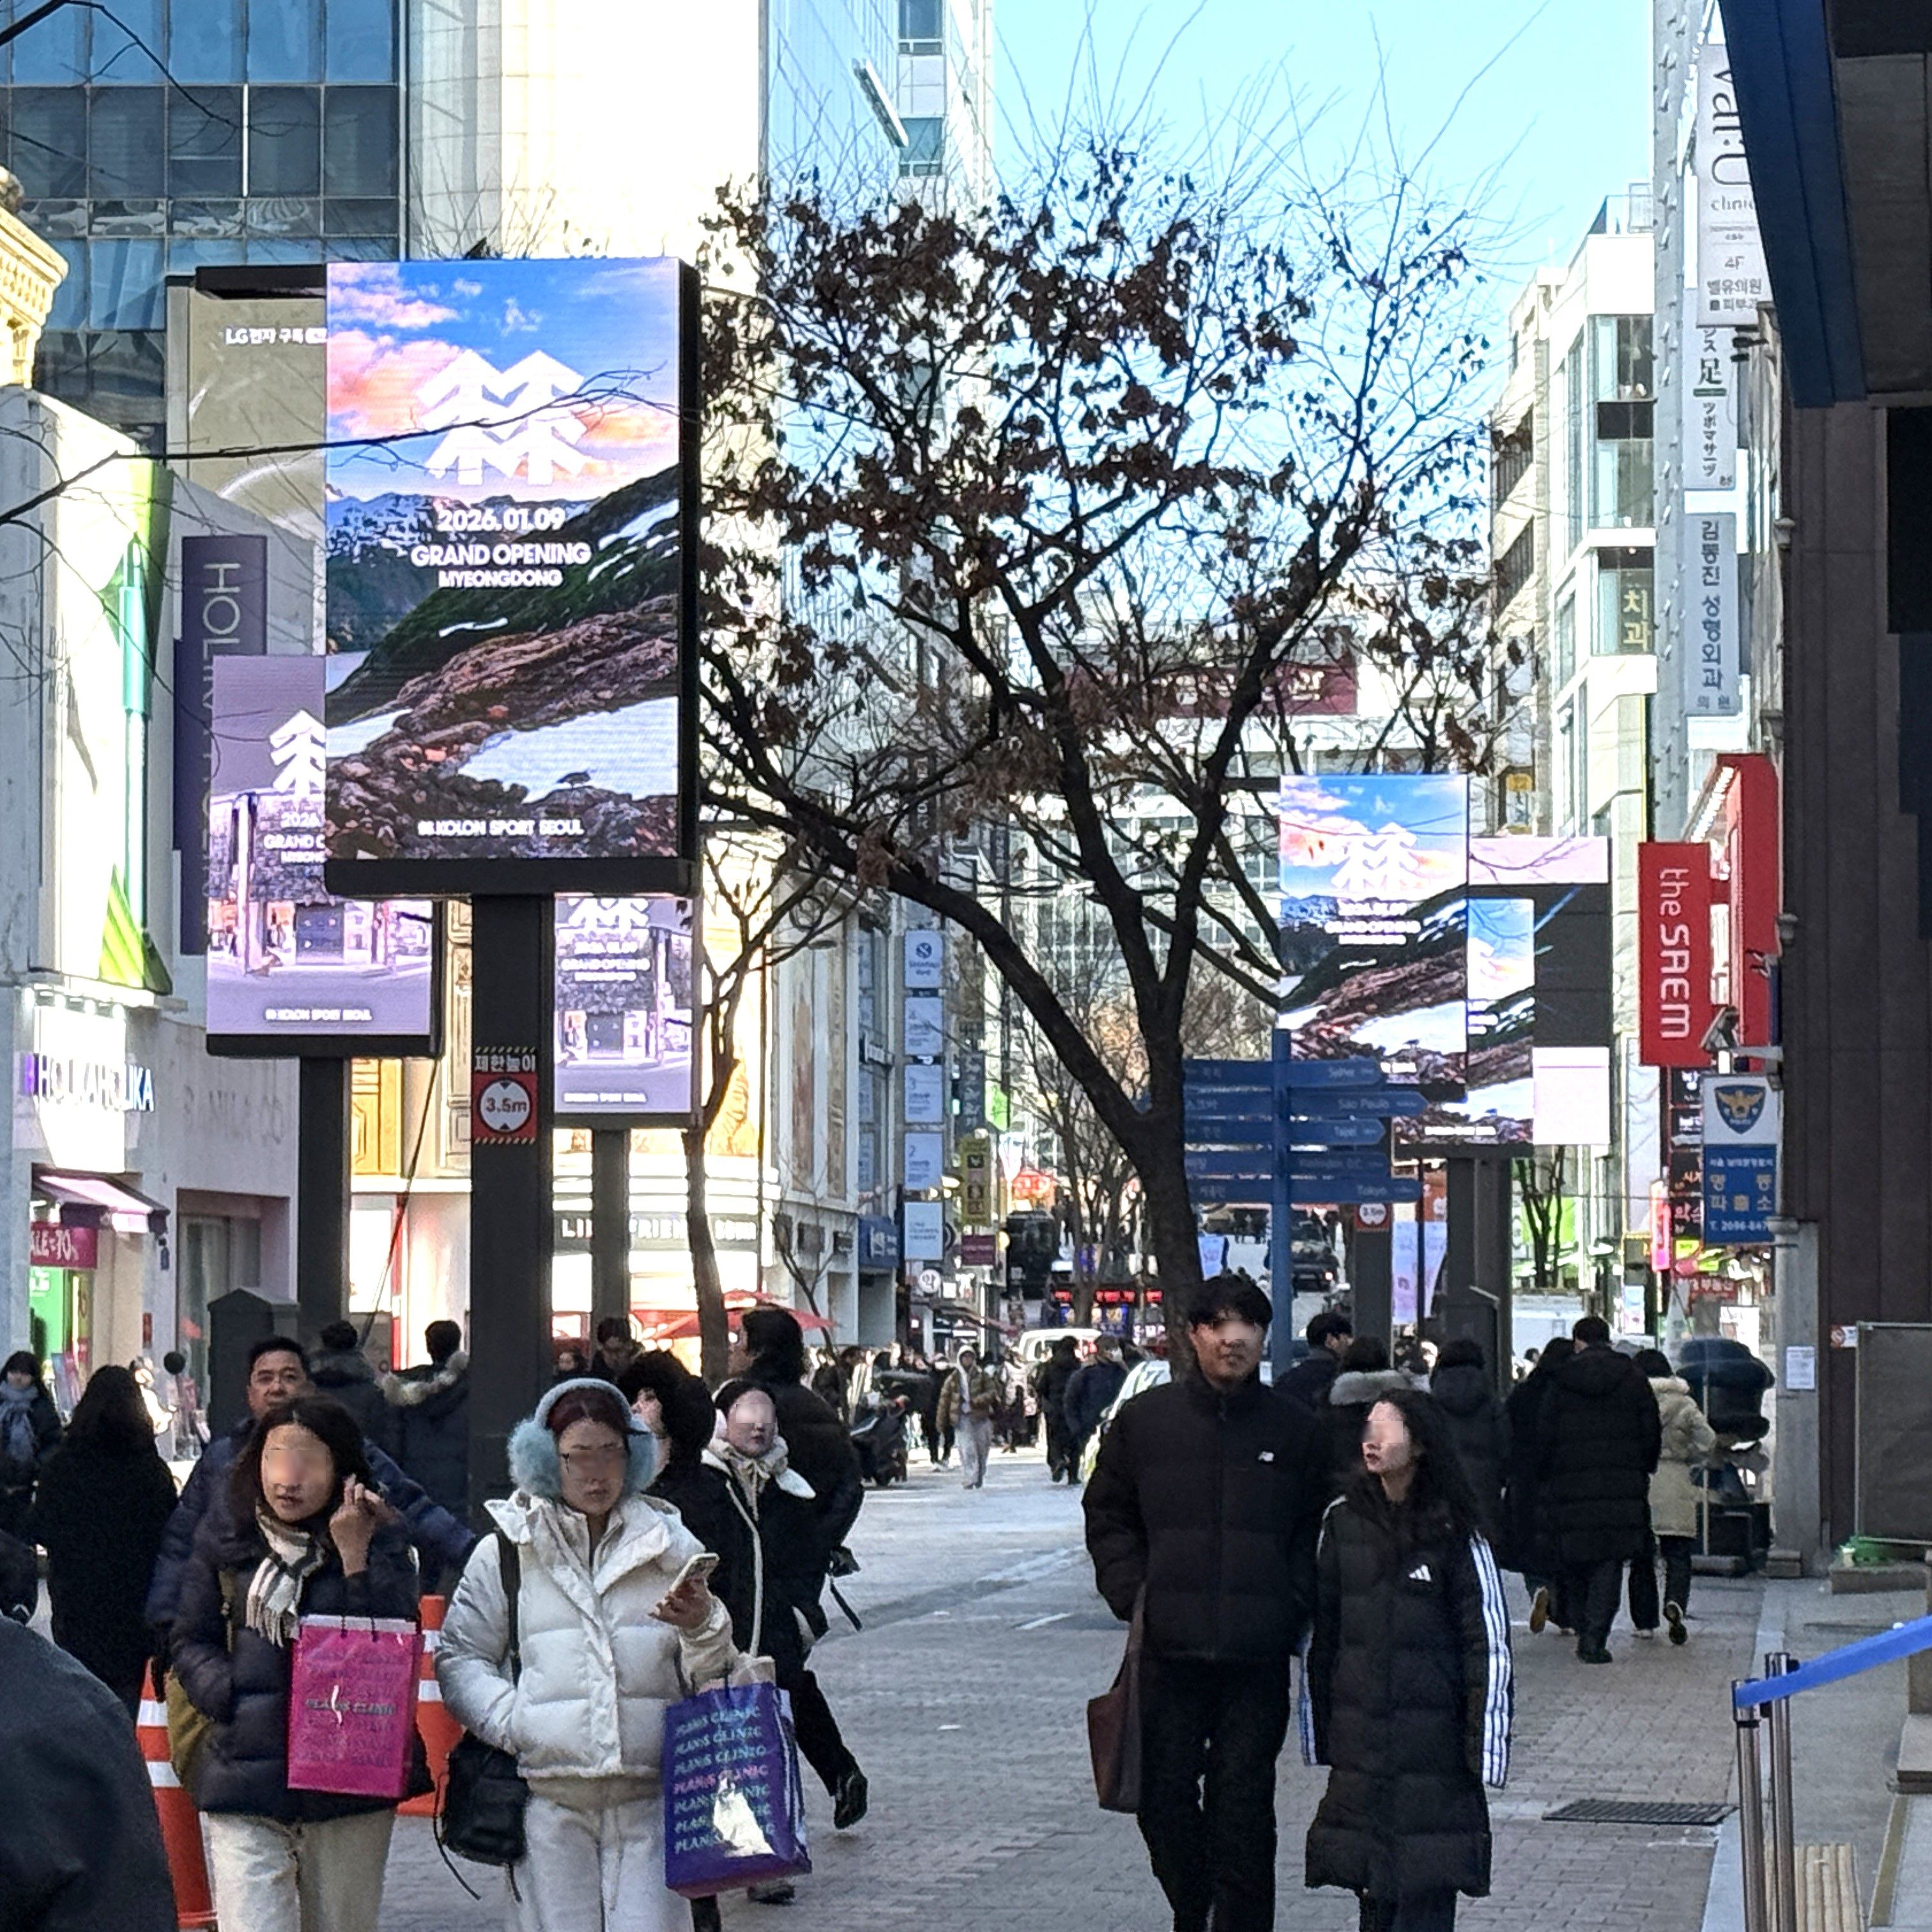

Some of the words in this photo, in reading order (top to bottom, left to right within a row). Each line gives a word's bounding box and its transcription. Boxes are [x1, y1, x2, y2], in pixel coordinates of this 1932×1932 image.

[1698, 358, 1723, 385] 足
[436, 507, 566, 532] 2026.01.09
[410, 544, 491, 567] GRAND
[492, 542, 592, 565] OPENING
[438, 568, 564, 588] MYEONGDONG
[1623, 590, 1650, 652] 치과
[1659, 868, 1690, 916] the
[486, 1096, 528, 1113] 3.5m
